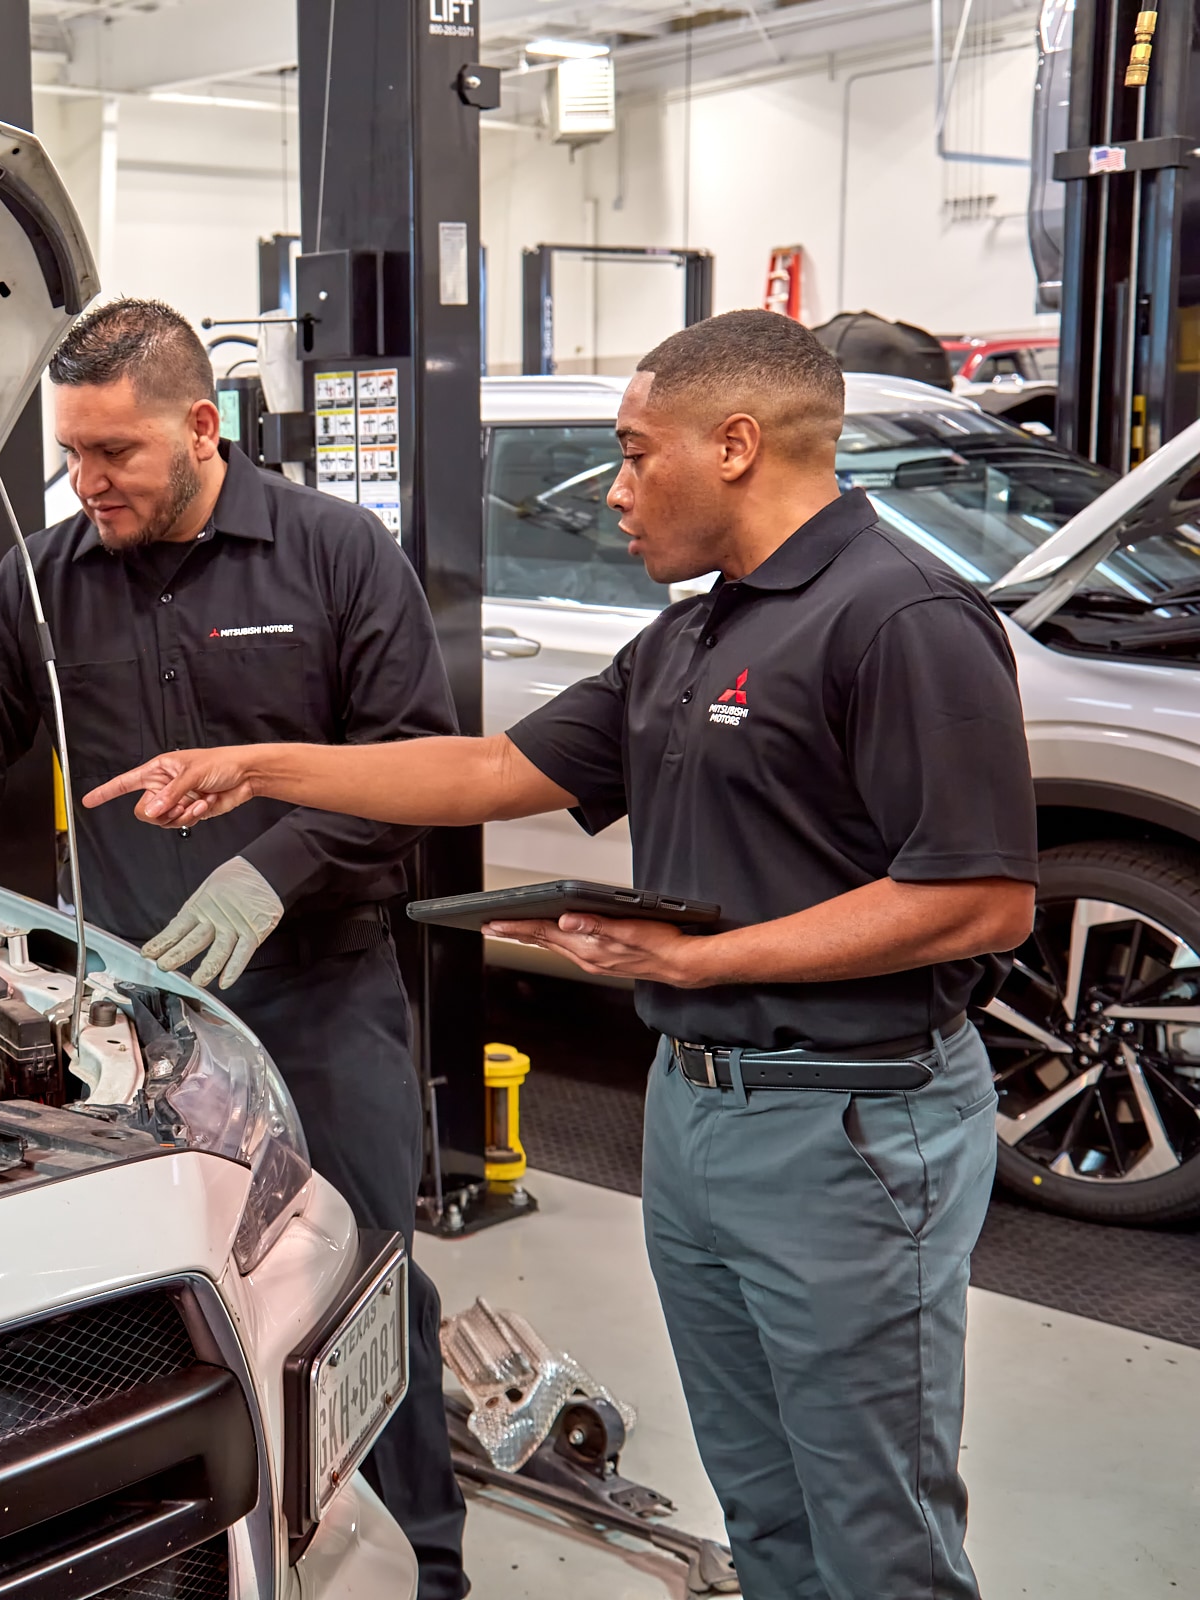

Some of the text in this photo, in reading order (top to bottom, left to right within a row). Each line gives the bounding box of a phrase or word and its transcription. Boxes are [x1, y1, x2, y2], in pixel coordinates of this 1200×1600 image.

[430, 0, 474, 24] LIFT
[220, 624, 294, 637] MITSUBISHI MOTORS
[708, 703, 749, 718] MITSUBISHI
[709, 713, 741, 726] MOTORS
[341, 1298, 378, 1363] TEXAS
